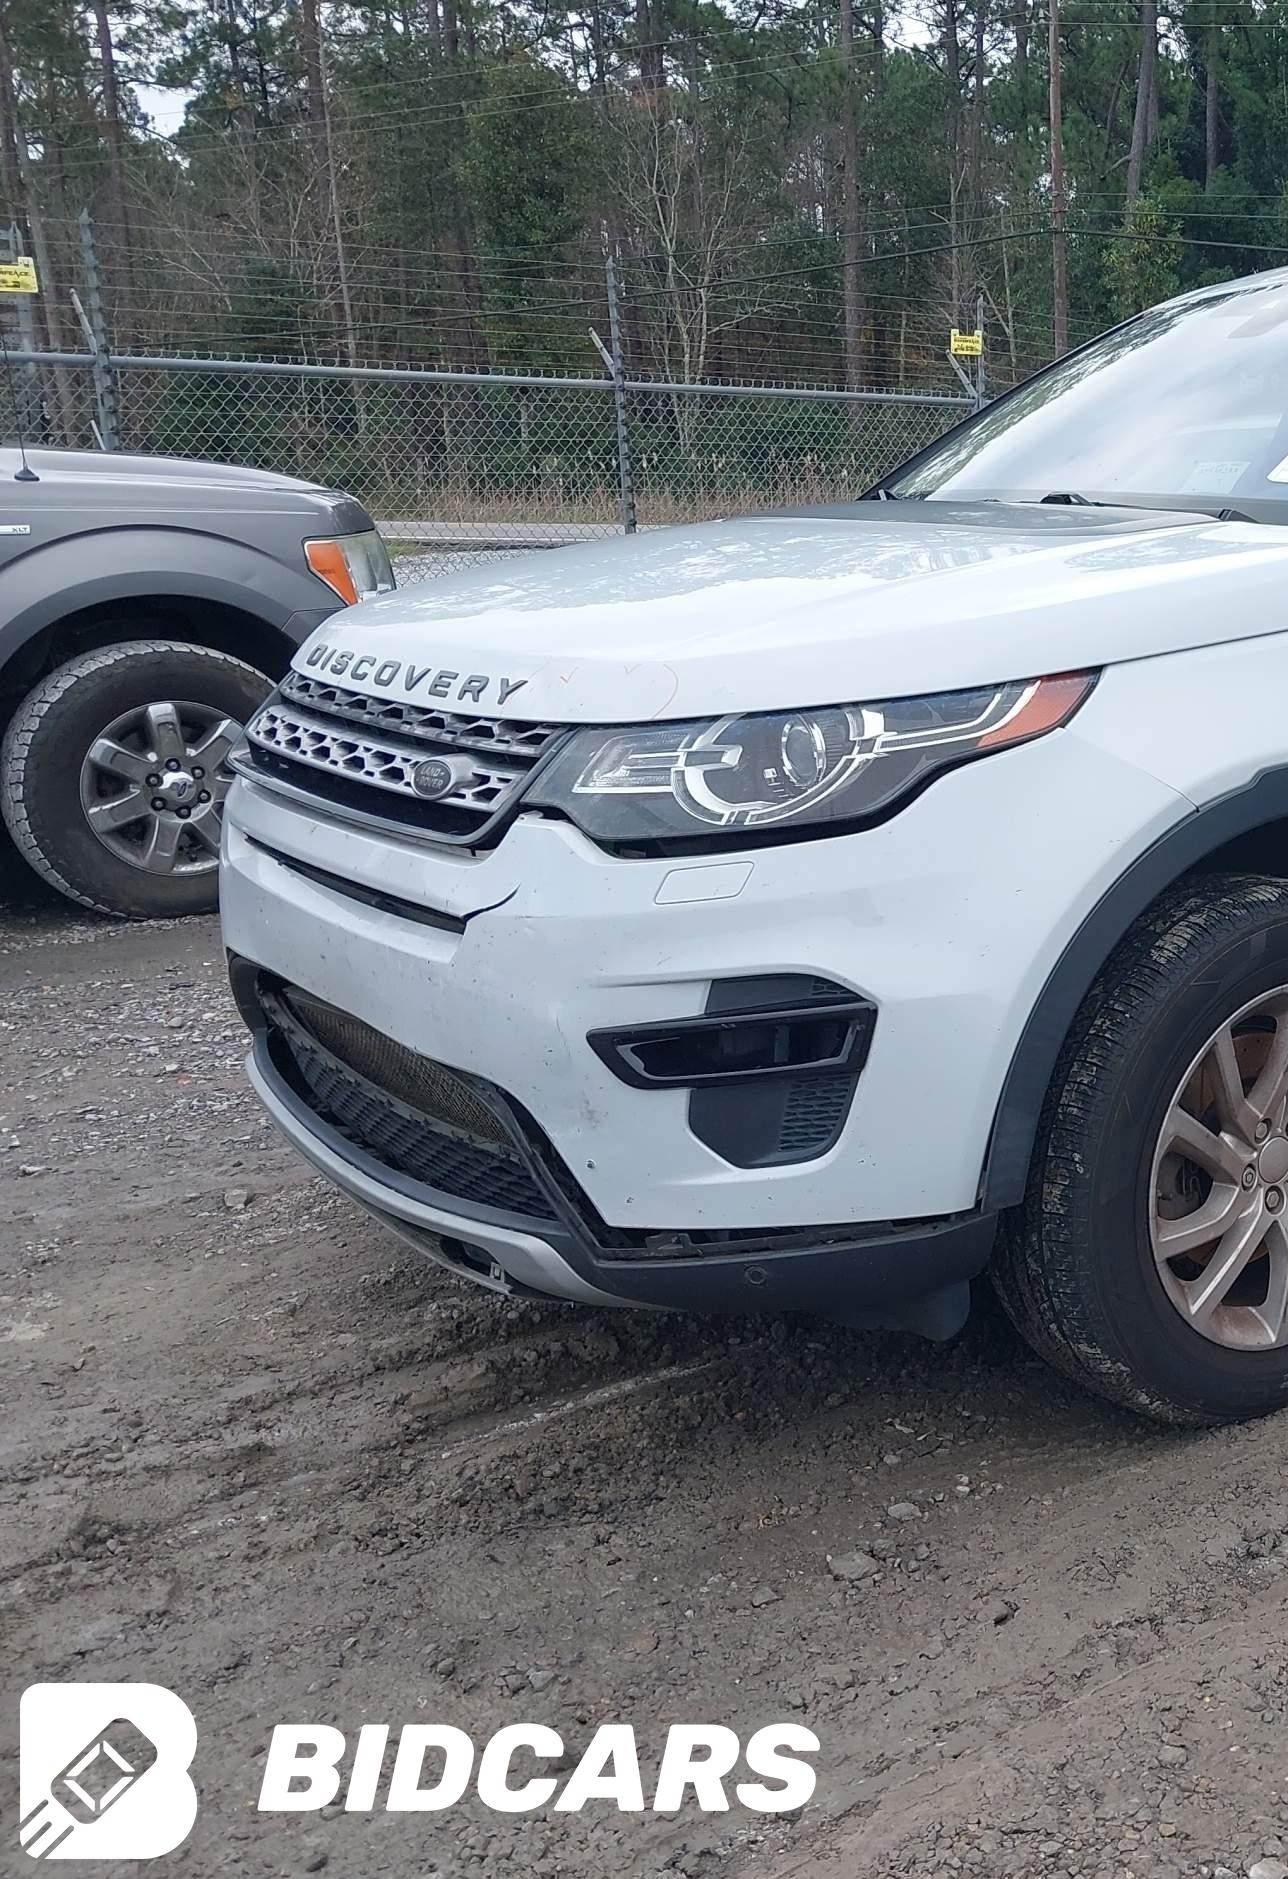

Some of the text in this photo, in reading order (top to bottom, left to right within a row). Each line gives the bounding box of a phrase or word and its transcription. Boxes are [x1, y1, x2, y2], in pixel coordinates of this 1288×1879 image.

[306, 644, 528, 705] DISCOVERY
[419, 766, 442, 777] LAND
[418, 774, 444, 790] ROVER
